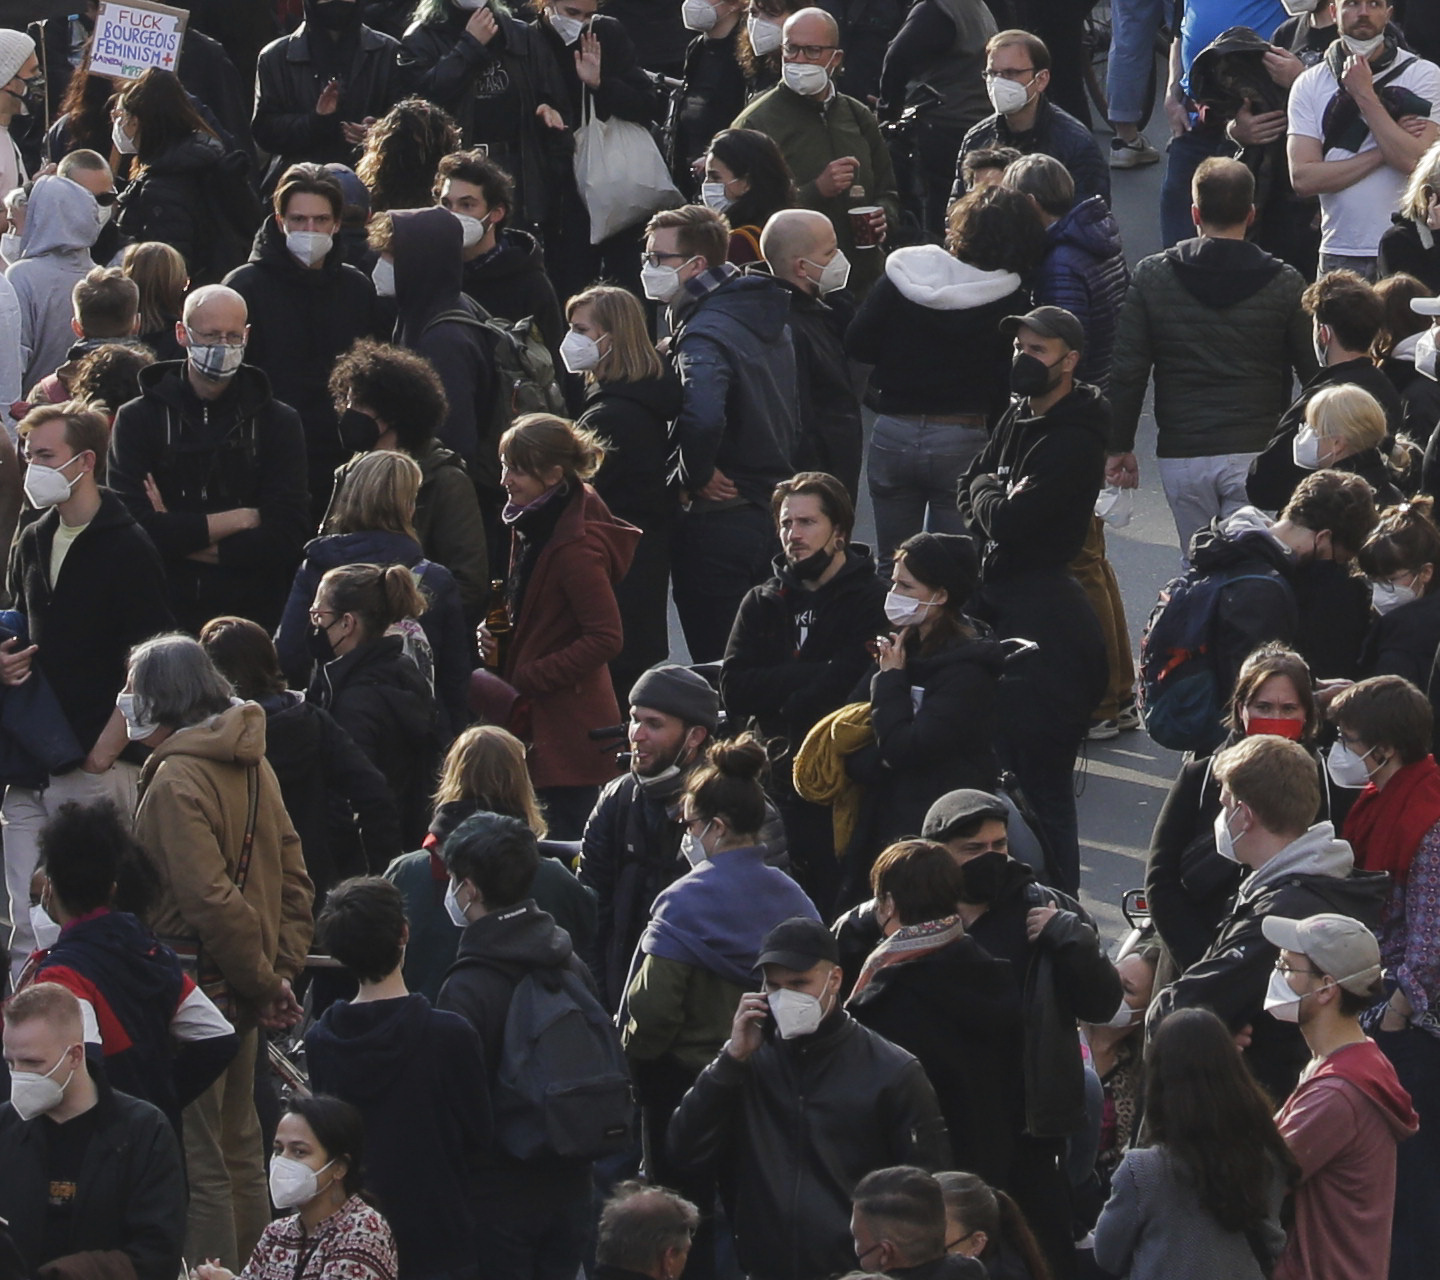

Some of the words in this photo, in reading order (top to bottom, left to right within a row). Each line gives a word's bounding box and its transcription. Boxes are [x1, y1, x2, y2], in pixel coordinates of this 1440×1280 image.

[118, 9, 164, 31] FUCK
[103, 21, 177, 52] BOURGEOIS
[96, 38, 162, 66] FEMINISM
